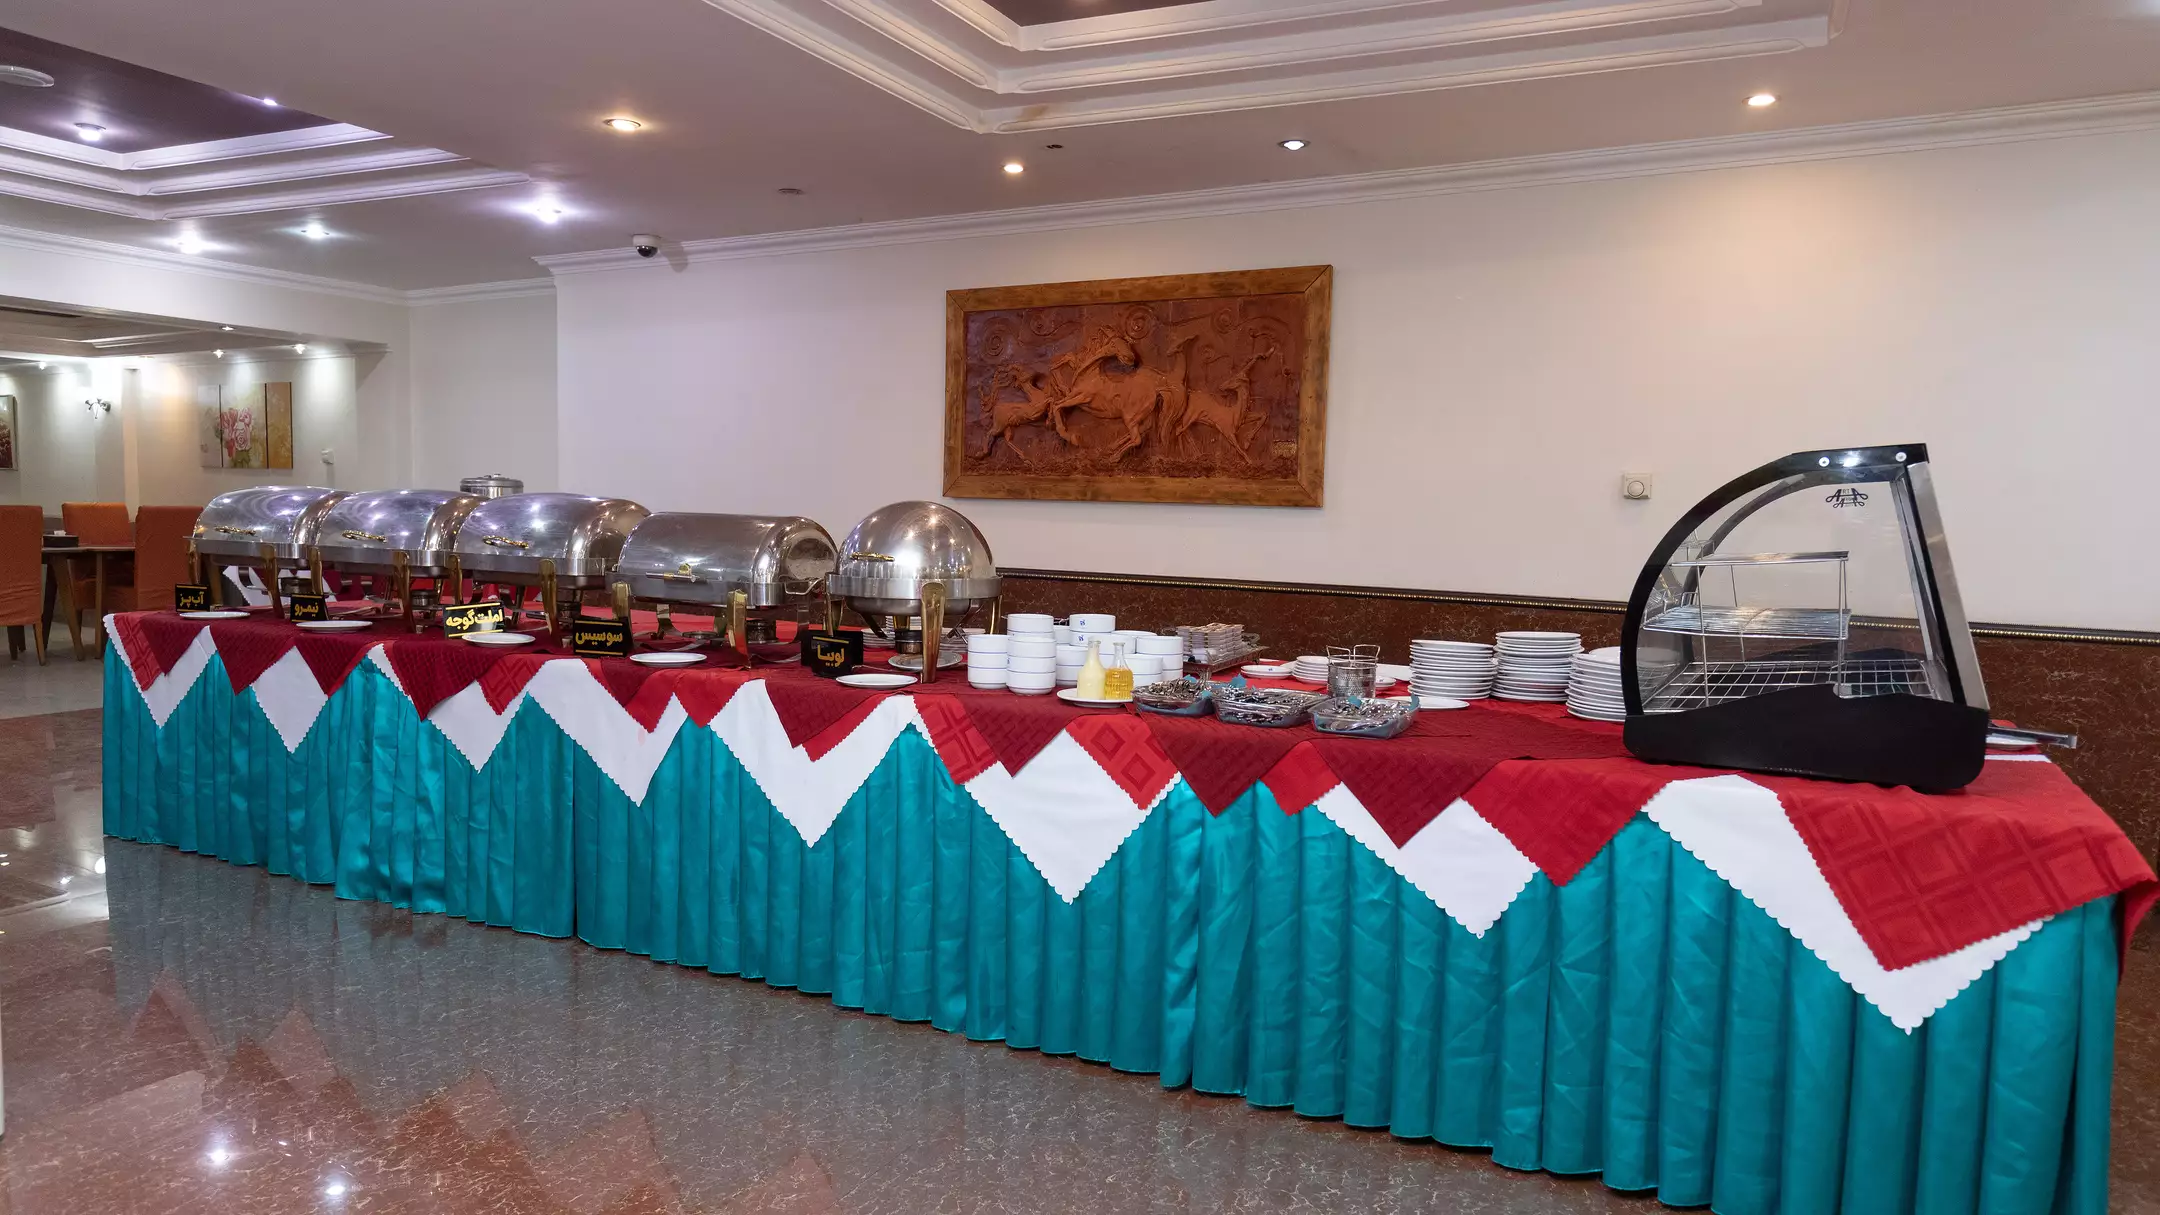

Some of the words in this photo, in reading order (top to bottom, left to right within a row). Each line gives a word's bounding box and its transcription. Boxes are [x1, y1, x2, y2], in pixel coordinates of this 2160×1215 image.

[295, 602, 319, 617] نیمرو
[475, 608, 504, 624] املت
[446, 608, 475, 630] گوجه
[575, 631, 623, 646] سوسیس
[817, 644, 845, 667] لوبیا
